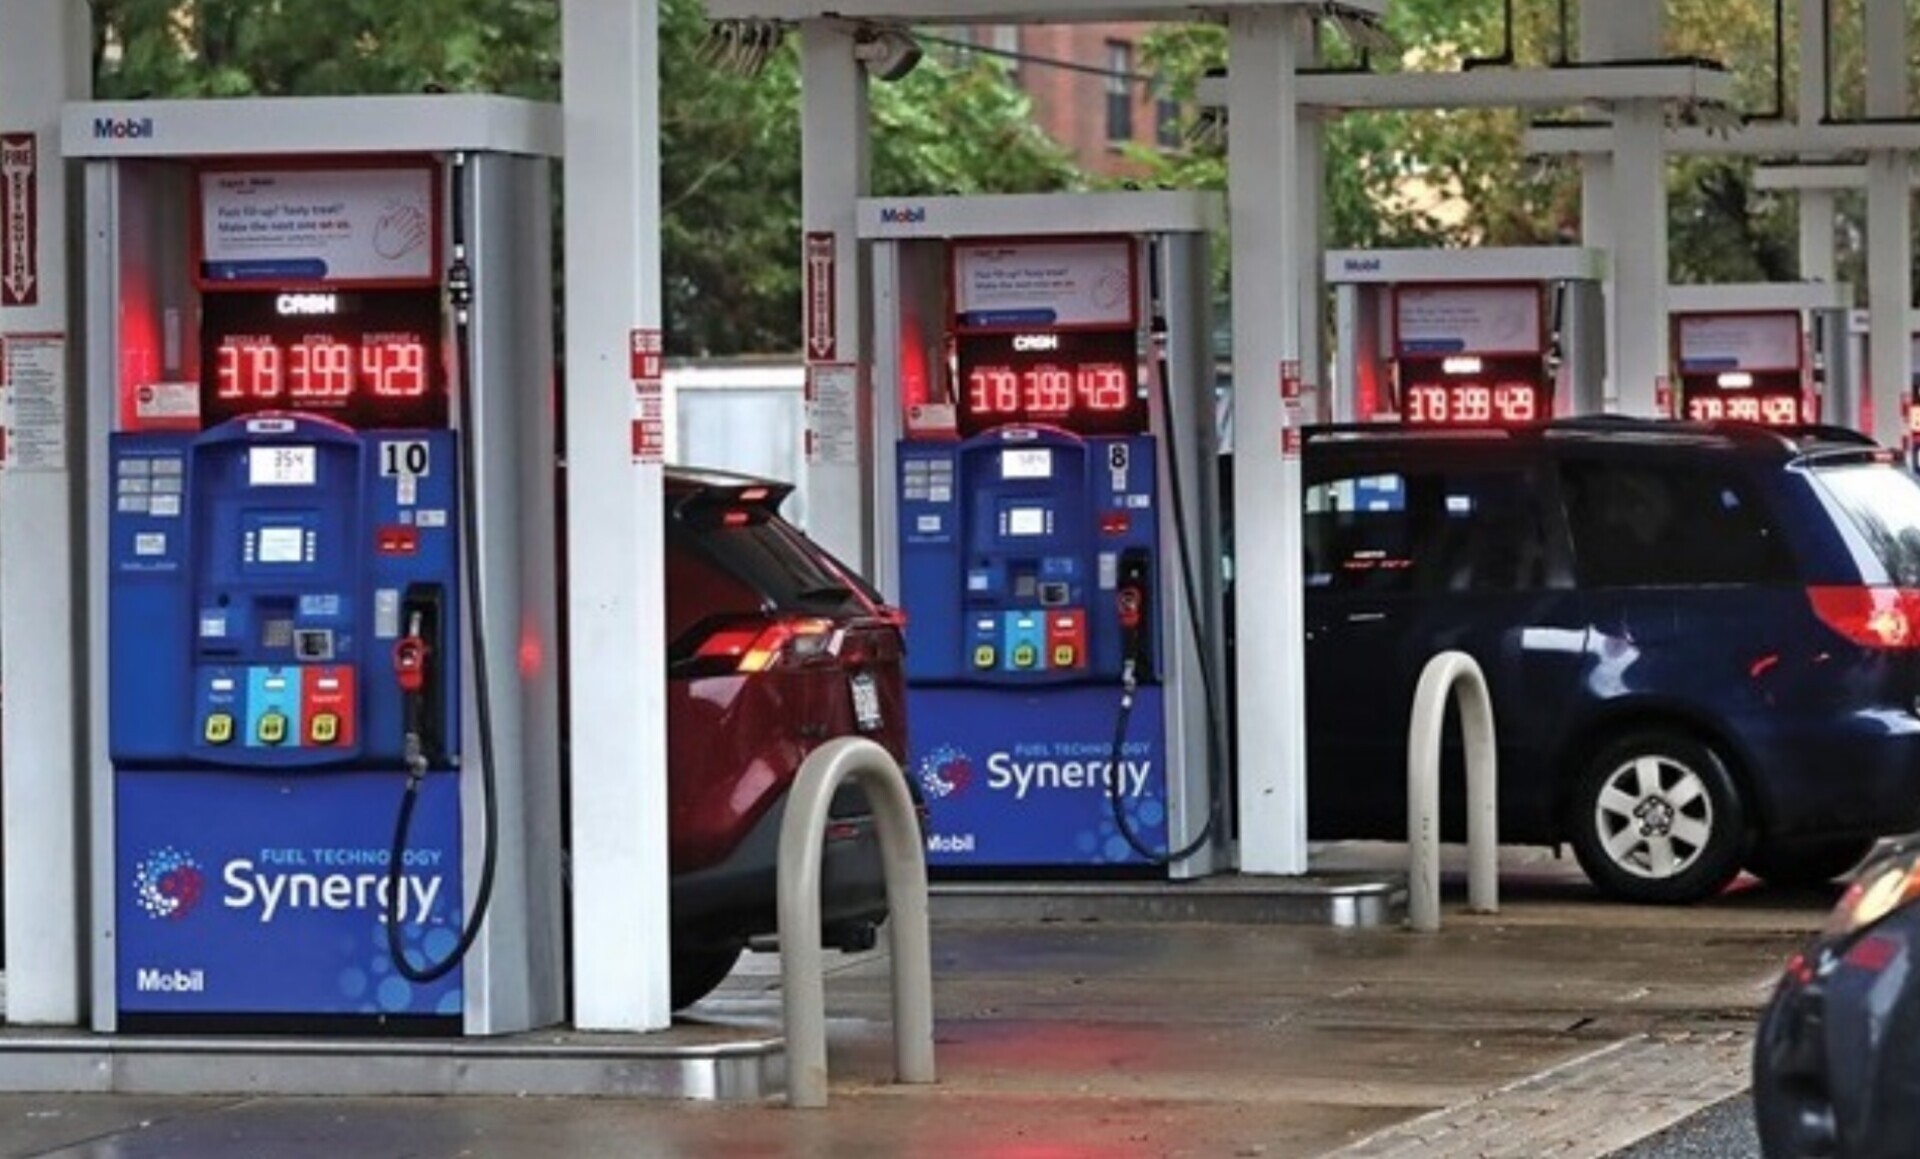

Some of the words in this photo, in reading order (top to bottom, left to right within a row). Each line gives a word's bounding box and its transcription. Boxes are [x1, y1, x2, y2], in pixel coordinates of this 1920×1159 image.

[94, 117, 153, 138] Mobil
[882, 207, 925, 222] Mobil
[387, 443, 427, 474] 10
[1111, 444, 1126, 468] 8
[1054, 742, 1150, 756] TECHNOOGY
[987, 752, 1151, 799] Synergy
[927, 833, 975, 852] Mobil
[261, 848, 306, 863] FUEL
[312, 849, 442, 865] TECHNOOGY
[223, 860, 442, 922] Synergy
[137, 968, 204, 991] Mobil
